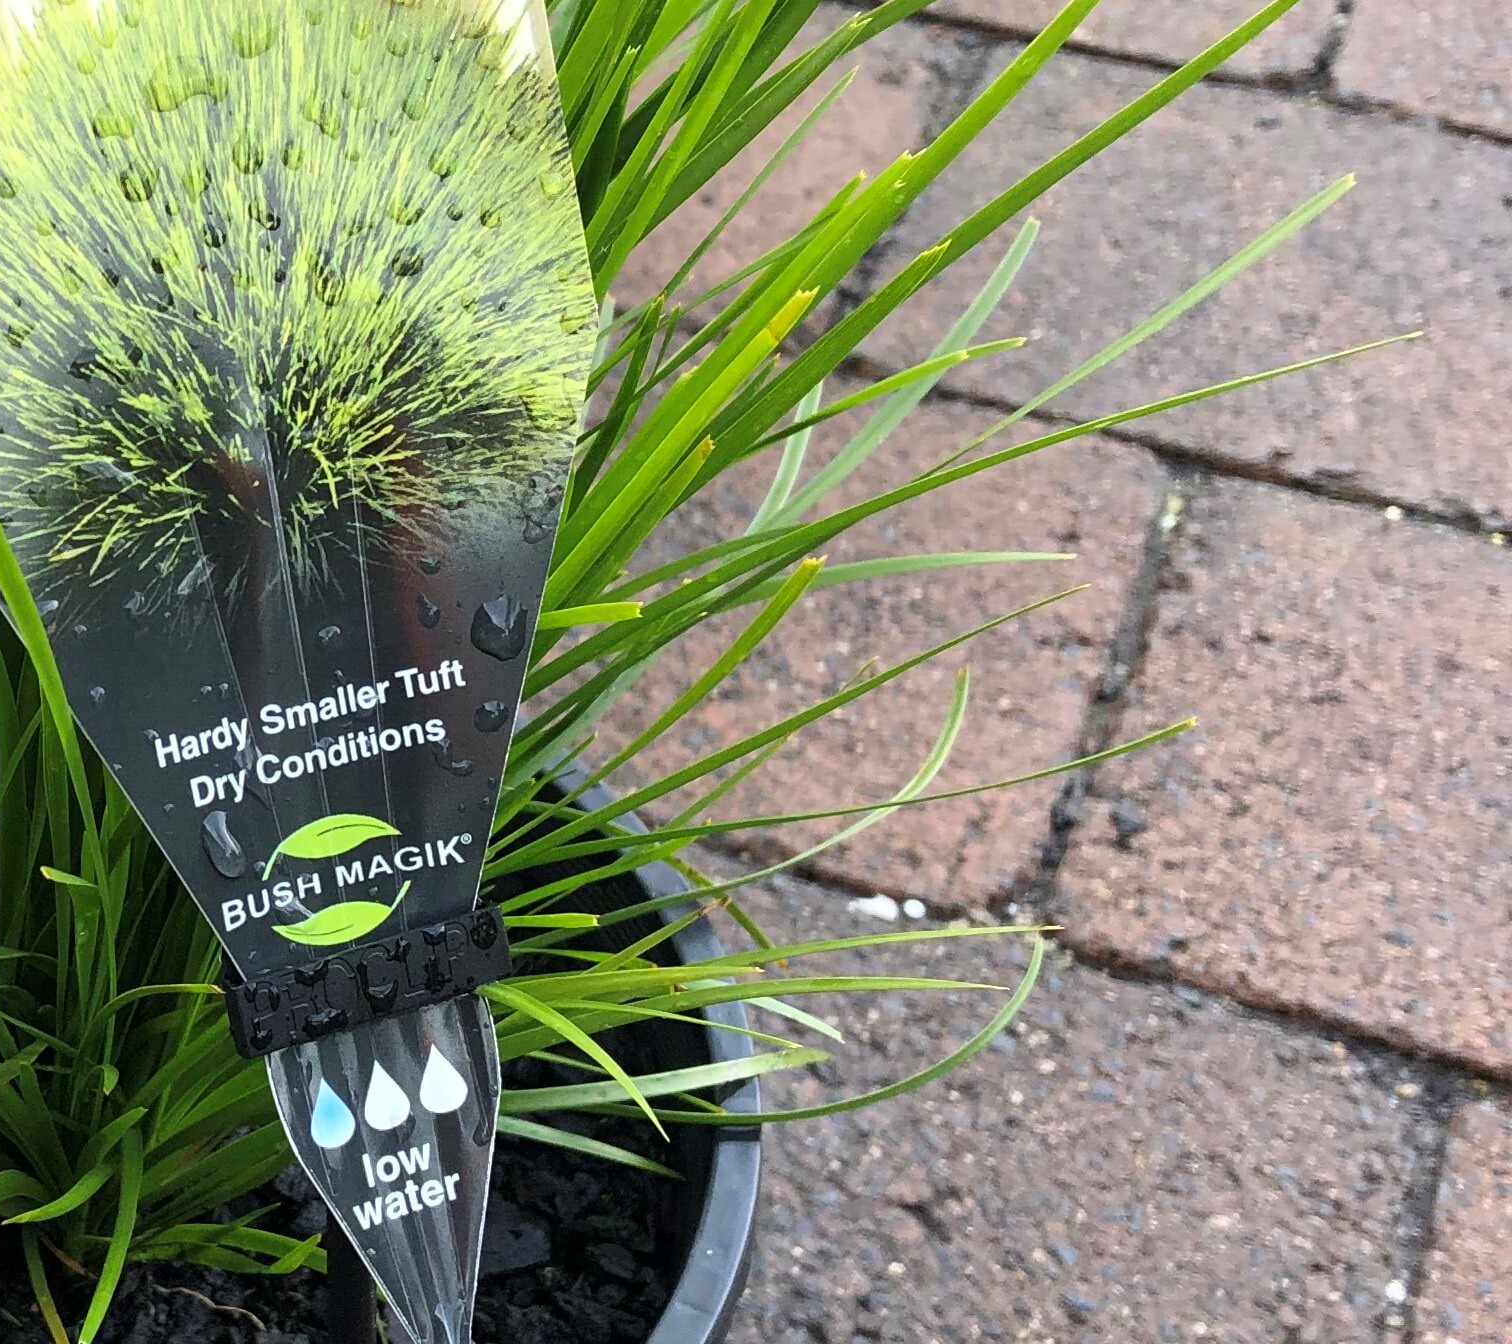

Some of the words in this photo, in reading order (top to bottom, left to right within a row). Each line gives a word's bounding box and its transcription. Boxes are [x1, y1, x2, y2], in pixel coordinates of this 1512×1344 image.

[154, 716, 249, 768] Hardy
[259, 677, 391, 735] Smaller
[395, 659, 466, 700] Tuft
[190, 769, 246, 809] Dry
[255, 718, 446, 785] Conditions
[221, 872, 322, 932] BUSH
[361, 1143, 431, 1188] low
[352, 1172, 460, 1230] water
